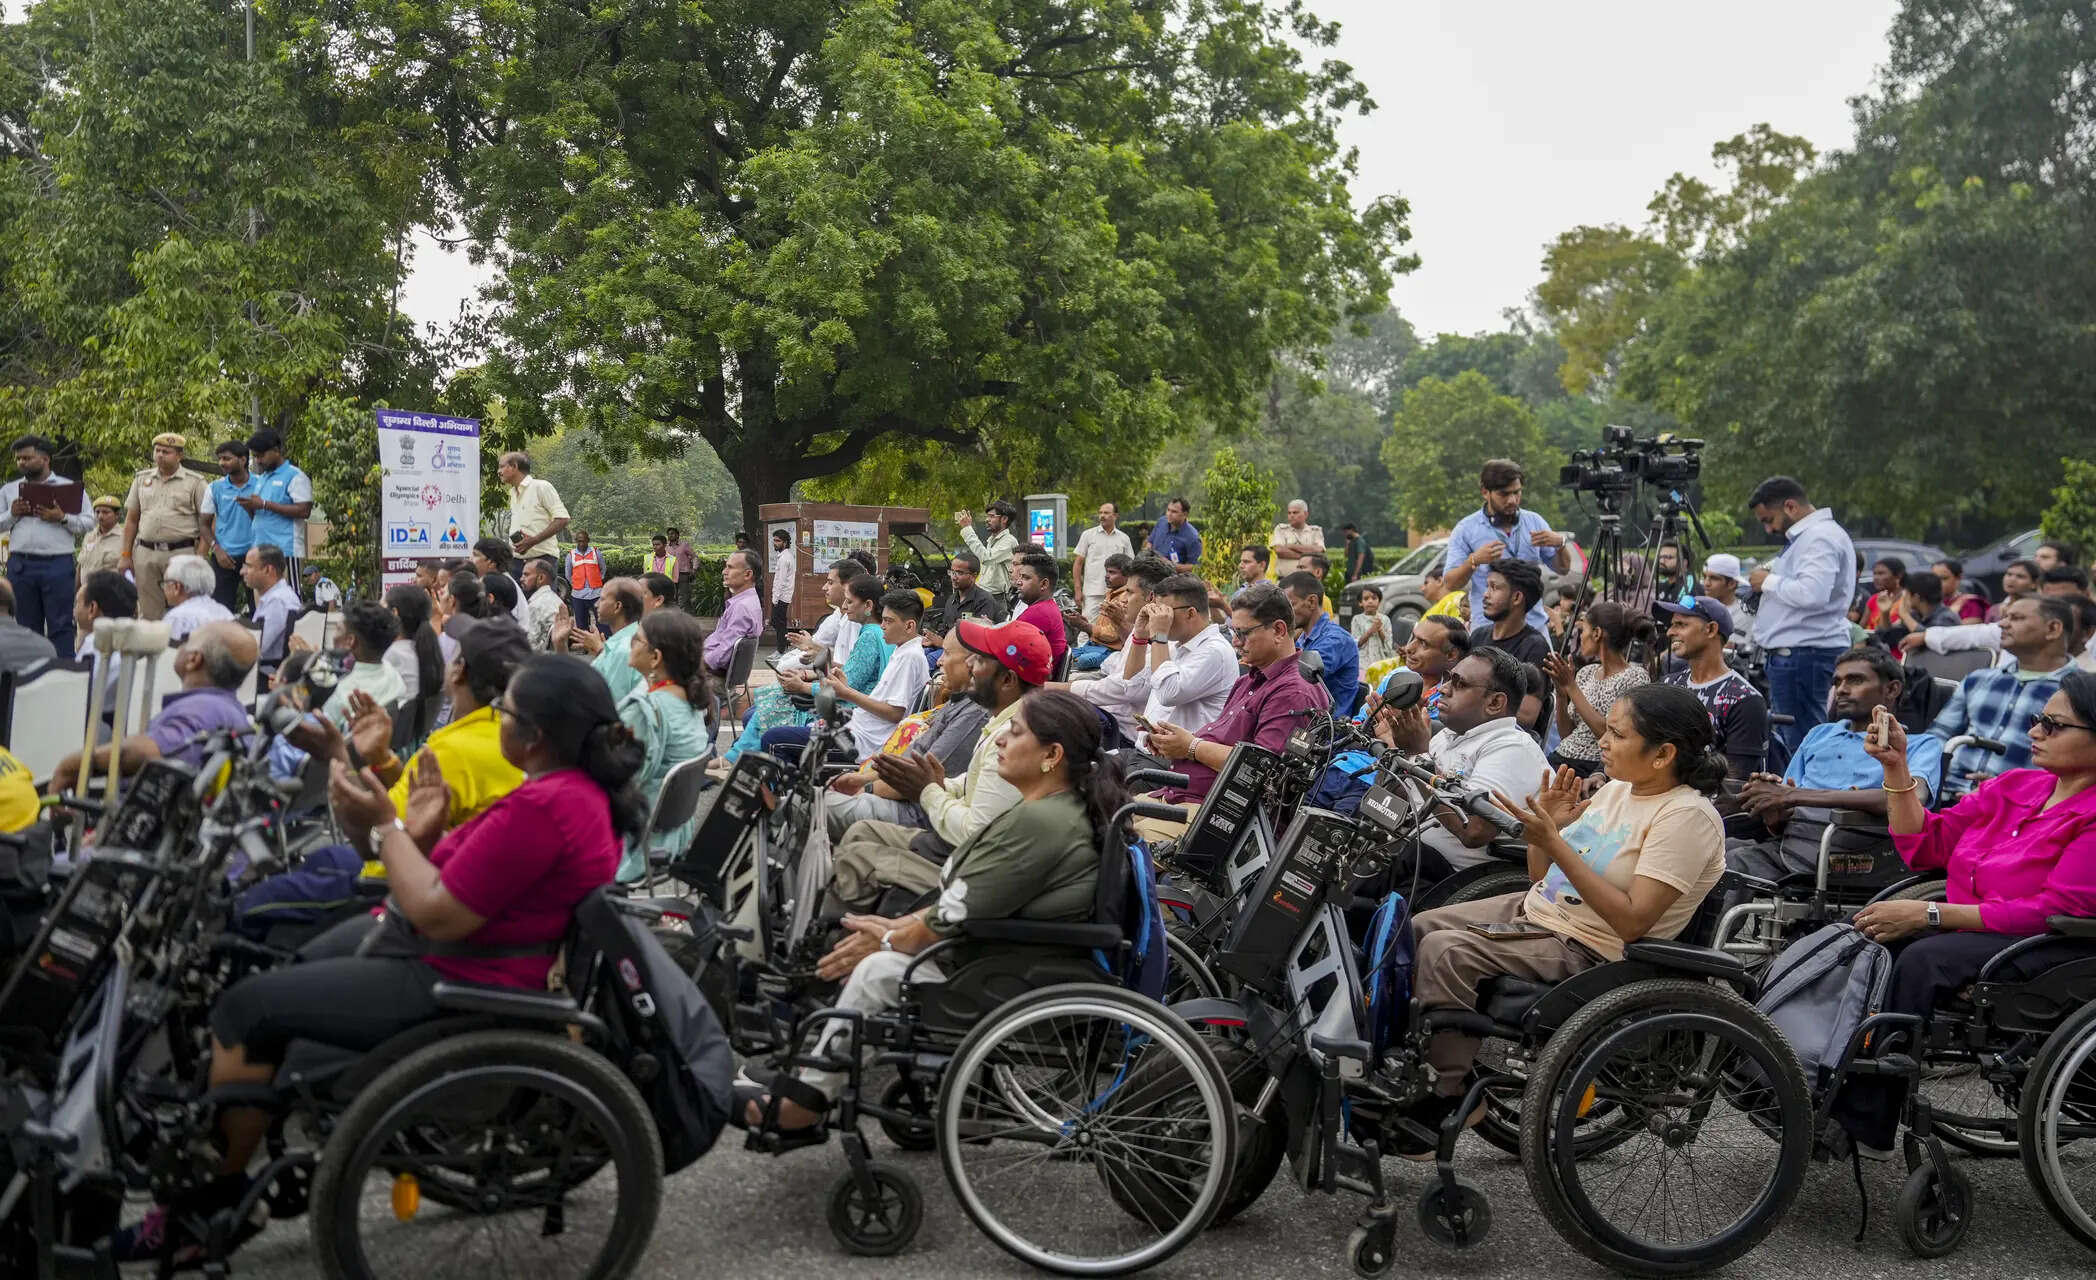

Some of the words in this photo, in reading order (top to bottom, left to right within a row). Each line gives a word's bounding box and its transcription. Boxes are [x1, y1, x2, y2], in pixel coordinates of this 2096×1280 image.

[382, 415, 411, 427] सुगम्य
[413, 416, 437, 428] दिल्ली
[439, 420, 473, 432] अभियान
[396, 485, 419, 493] Special
[390, 491, 419, 500] Olympics
[446, 494, 467, 504] Delhi
[391, 528, 428, 543] IDEA
[1367, 798, 1398, 821] NEOMOTION
